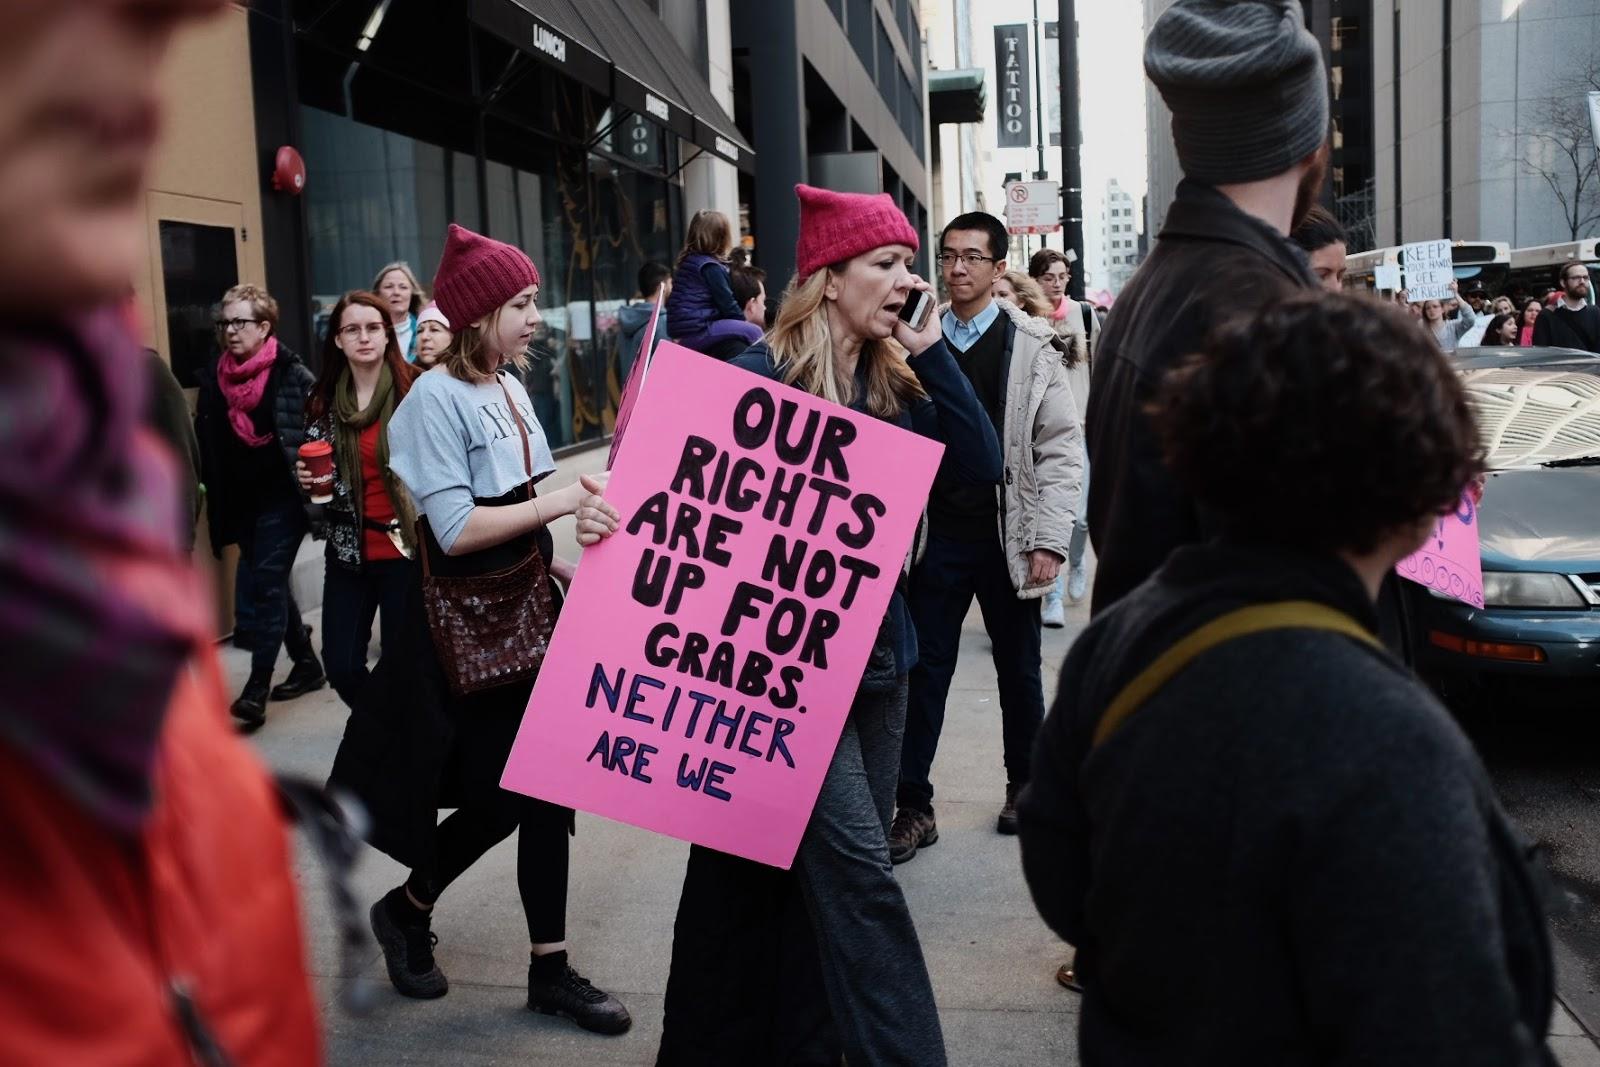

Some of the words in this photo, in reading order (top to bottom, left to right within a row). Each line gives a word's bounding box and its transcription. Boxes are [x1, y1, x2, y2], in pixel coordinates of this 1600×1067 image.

[533, 23, 566, 62] LUNCH
[1005, 37, 1022, 133] TATTOO
[1406, 242, 1446, 262] KEEP
[733, 387, 857, 482] OUR
[670, 435, 886, 549] RIGHTS
[626, 492, 743, 568] ARE
[761, 534, 880, 610] NOT
[632, 548, 705, 615] UP
[721, 581, 840, 670] FOR
[645, 622, 806, 713] GRABS.
[585, 663, 795, 769] NEITHER
[587, 731, 659, 784] ARE
[676, 753, 736, 802] WE
